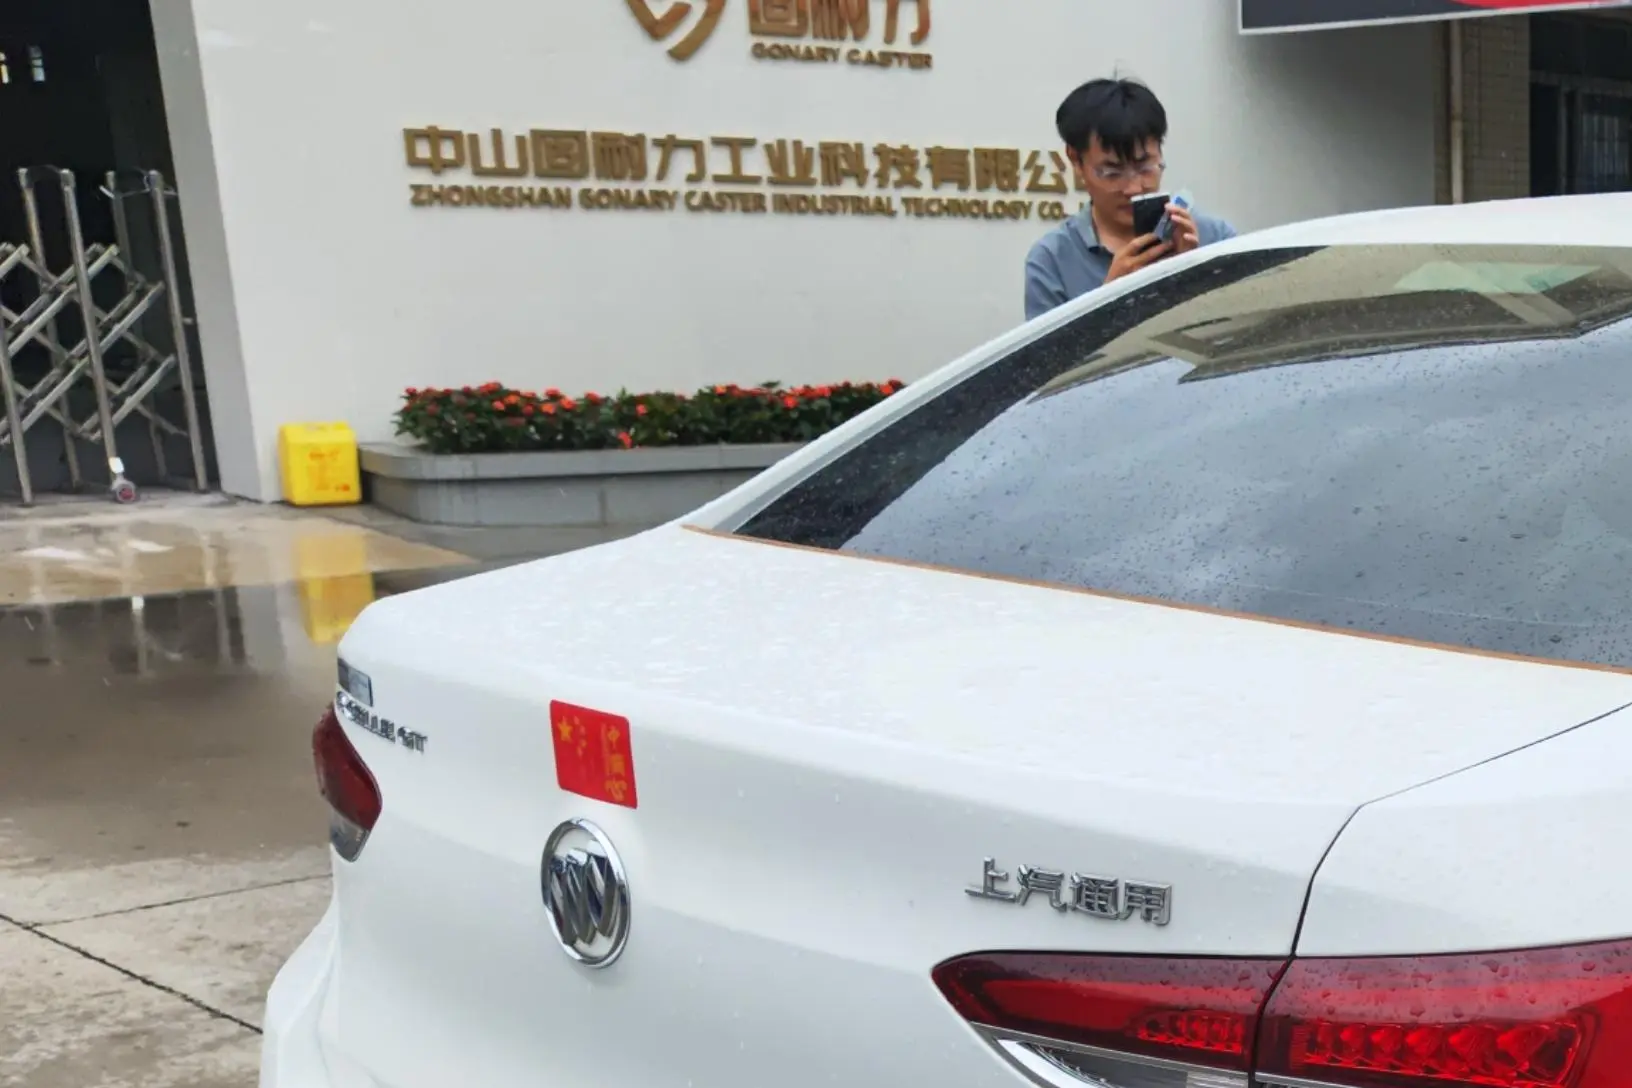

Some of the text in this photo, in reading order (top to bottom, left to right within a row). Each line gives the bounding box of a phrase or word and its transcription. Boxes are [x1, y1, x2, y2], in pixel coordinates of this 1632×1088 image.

[752, 42, 933, 68] GONARY CASTER
[403, 125, 1089, 195] 中山固耐力工业科技有限公
[408, 183, 572, 209] ZHONGSHAN
[578, 187, 678, 211] GONARY
[685, 190, 767, 213] CASTER
[771, 192, 898, 218] INDUSTRIAL
[901, 196, 1033, 220] TECHNOLOGY
[964, 856, 1173, 926] 上汽通用
